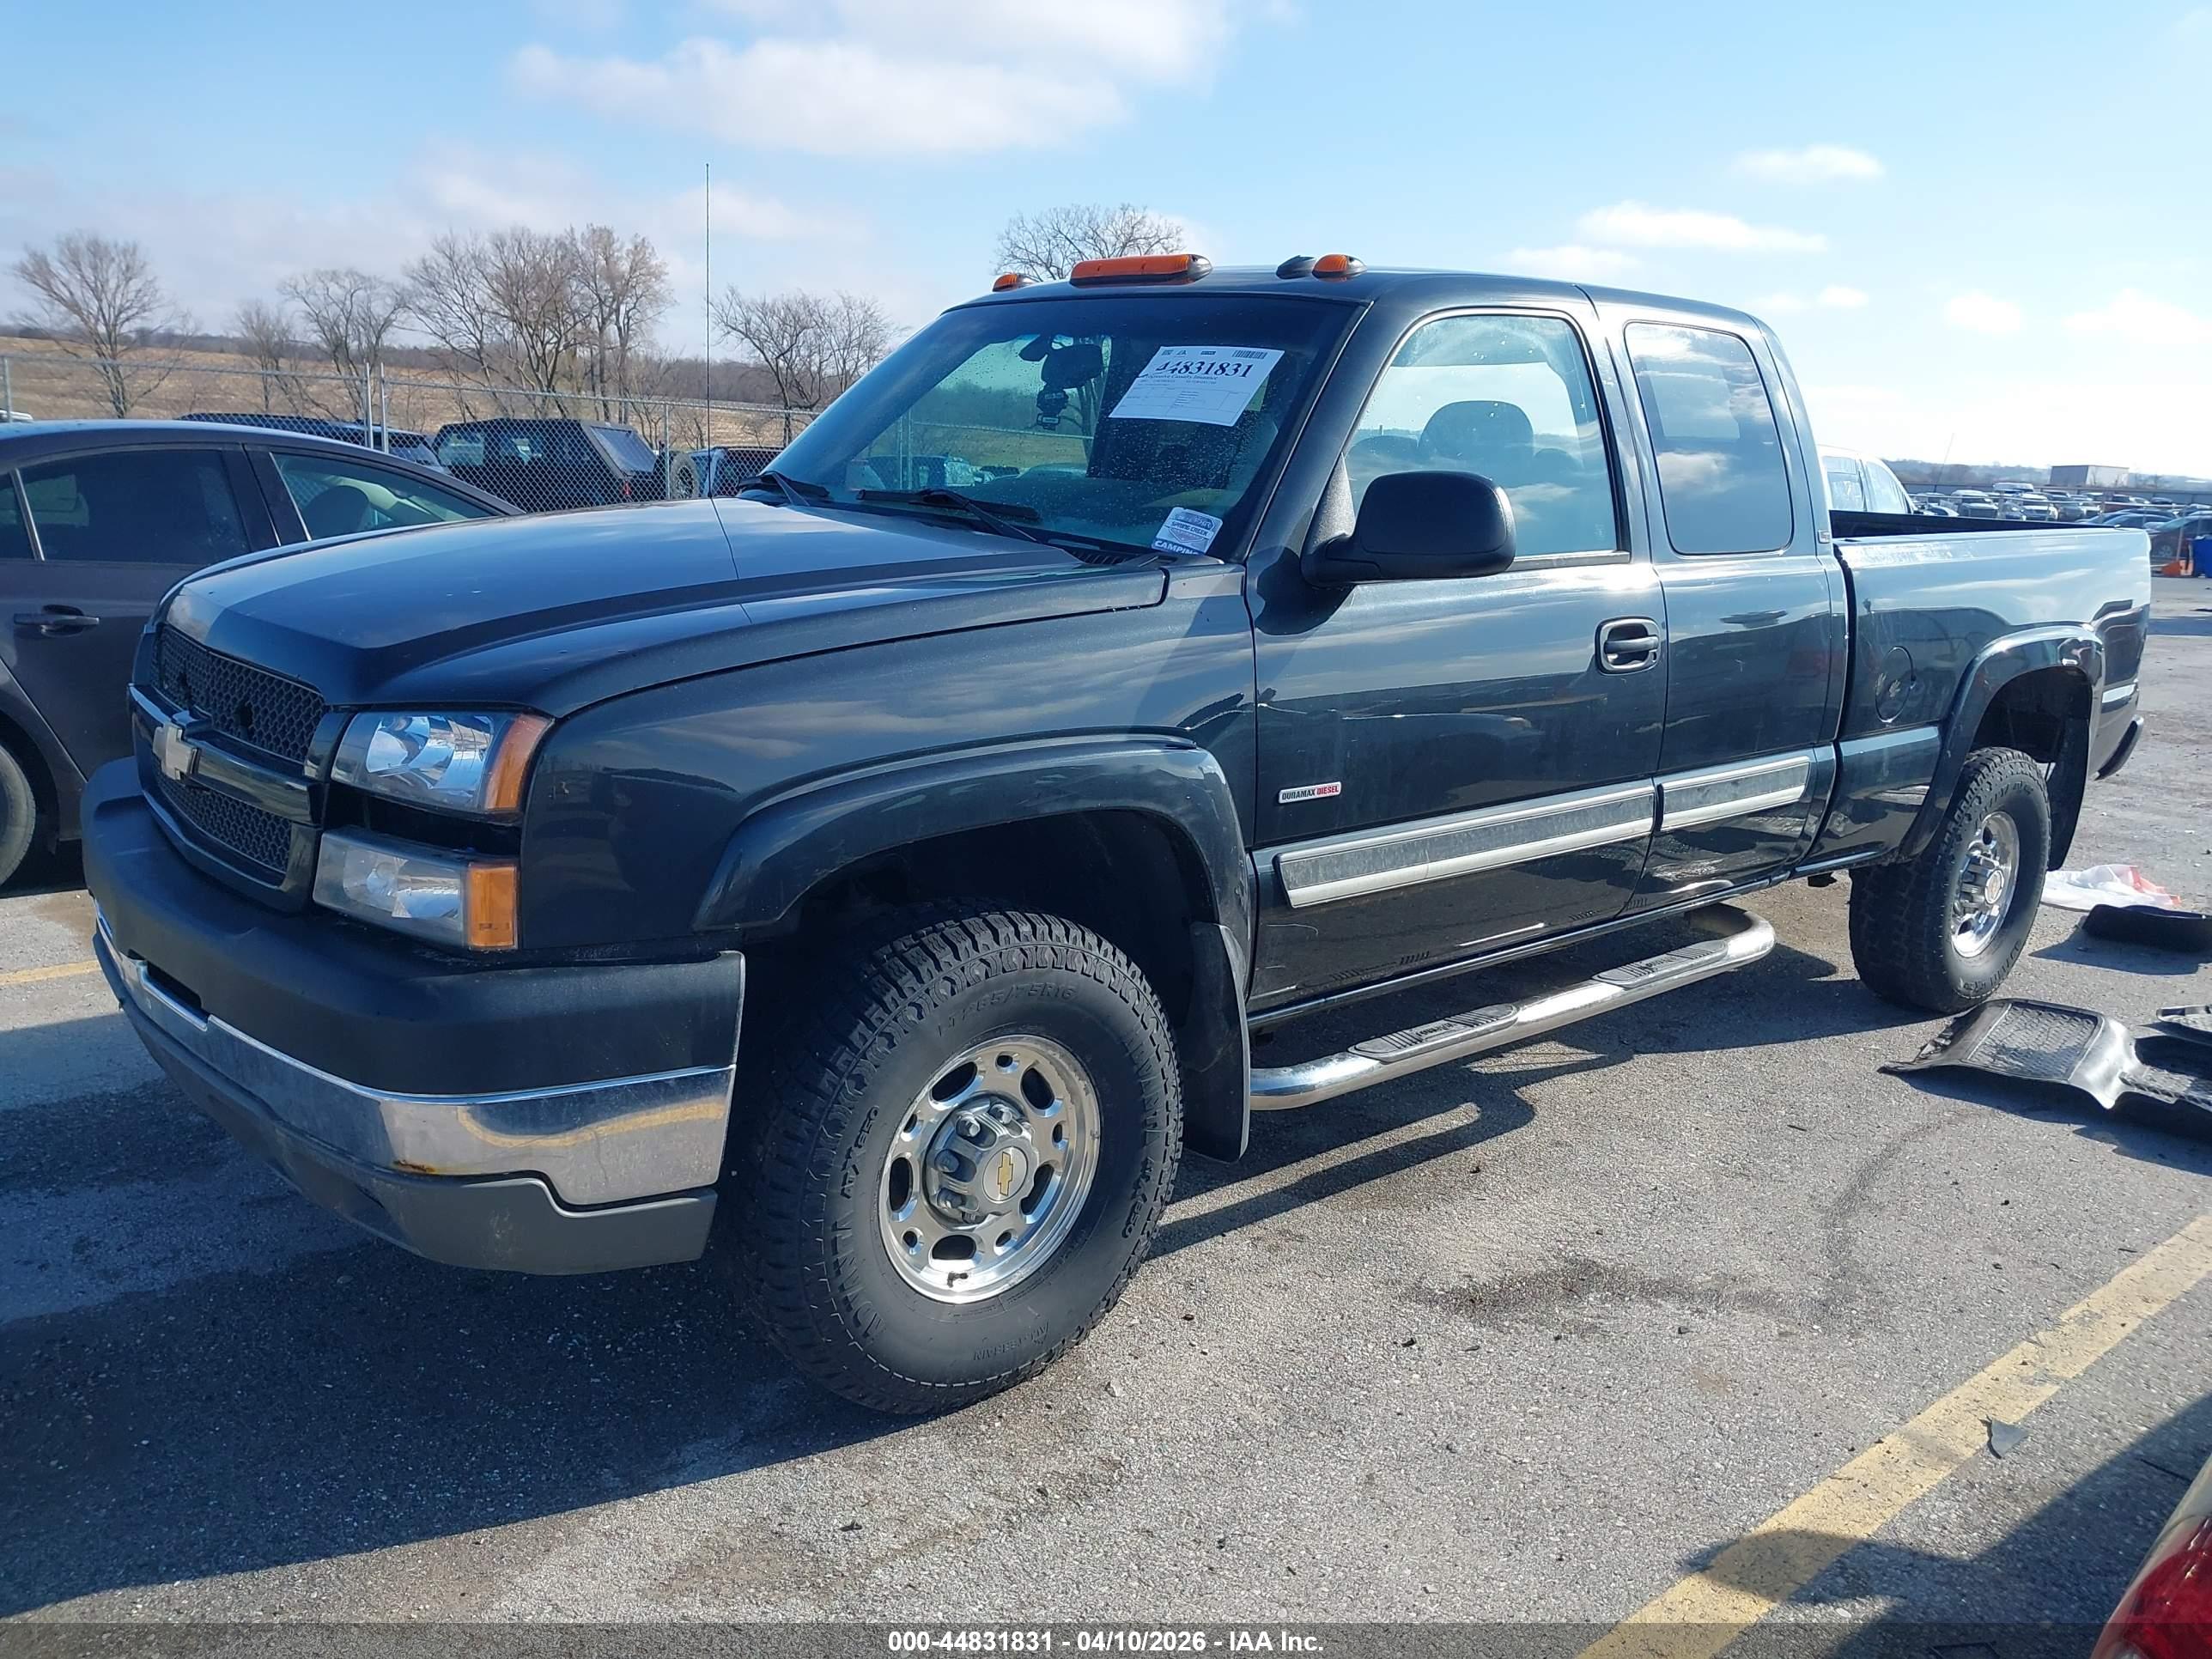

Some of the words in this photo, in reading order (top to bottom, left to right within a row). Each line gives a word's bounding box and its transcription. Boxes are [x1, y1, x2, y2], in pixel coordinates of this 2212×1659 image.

[1154, 361, 1255, 378] 44831831
[1281, 788, 1316, 801] DURAMAX
[1316, 785, 1340, 795] DIESEL
